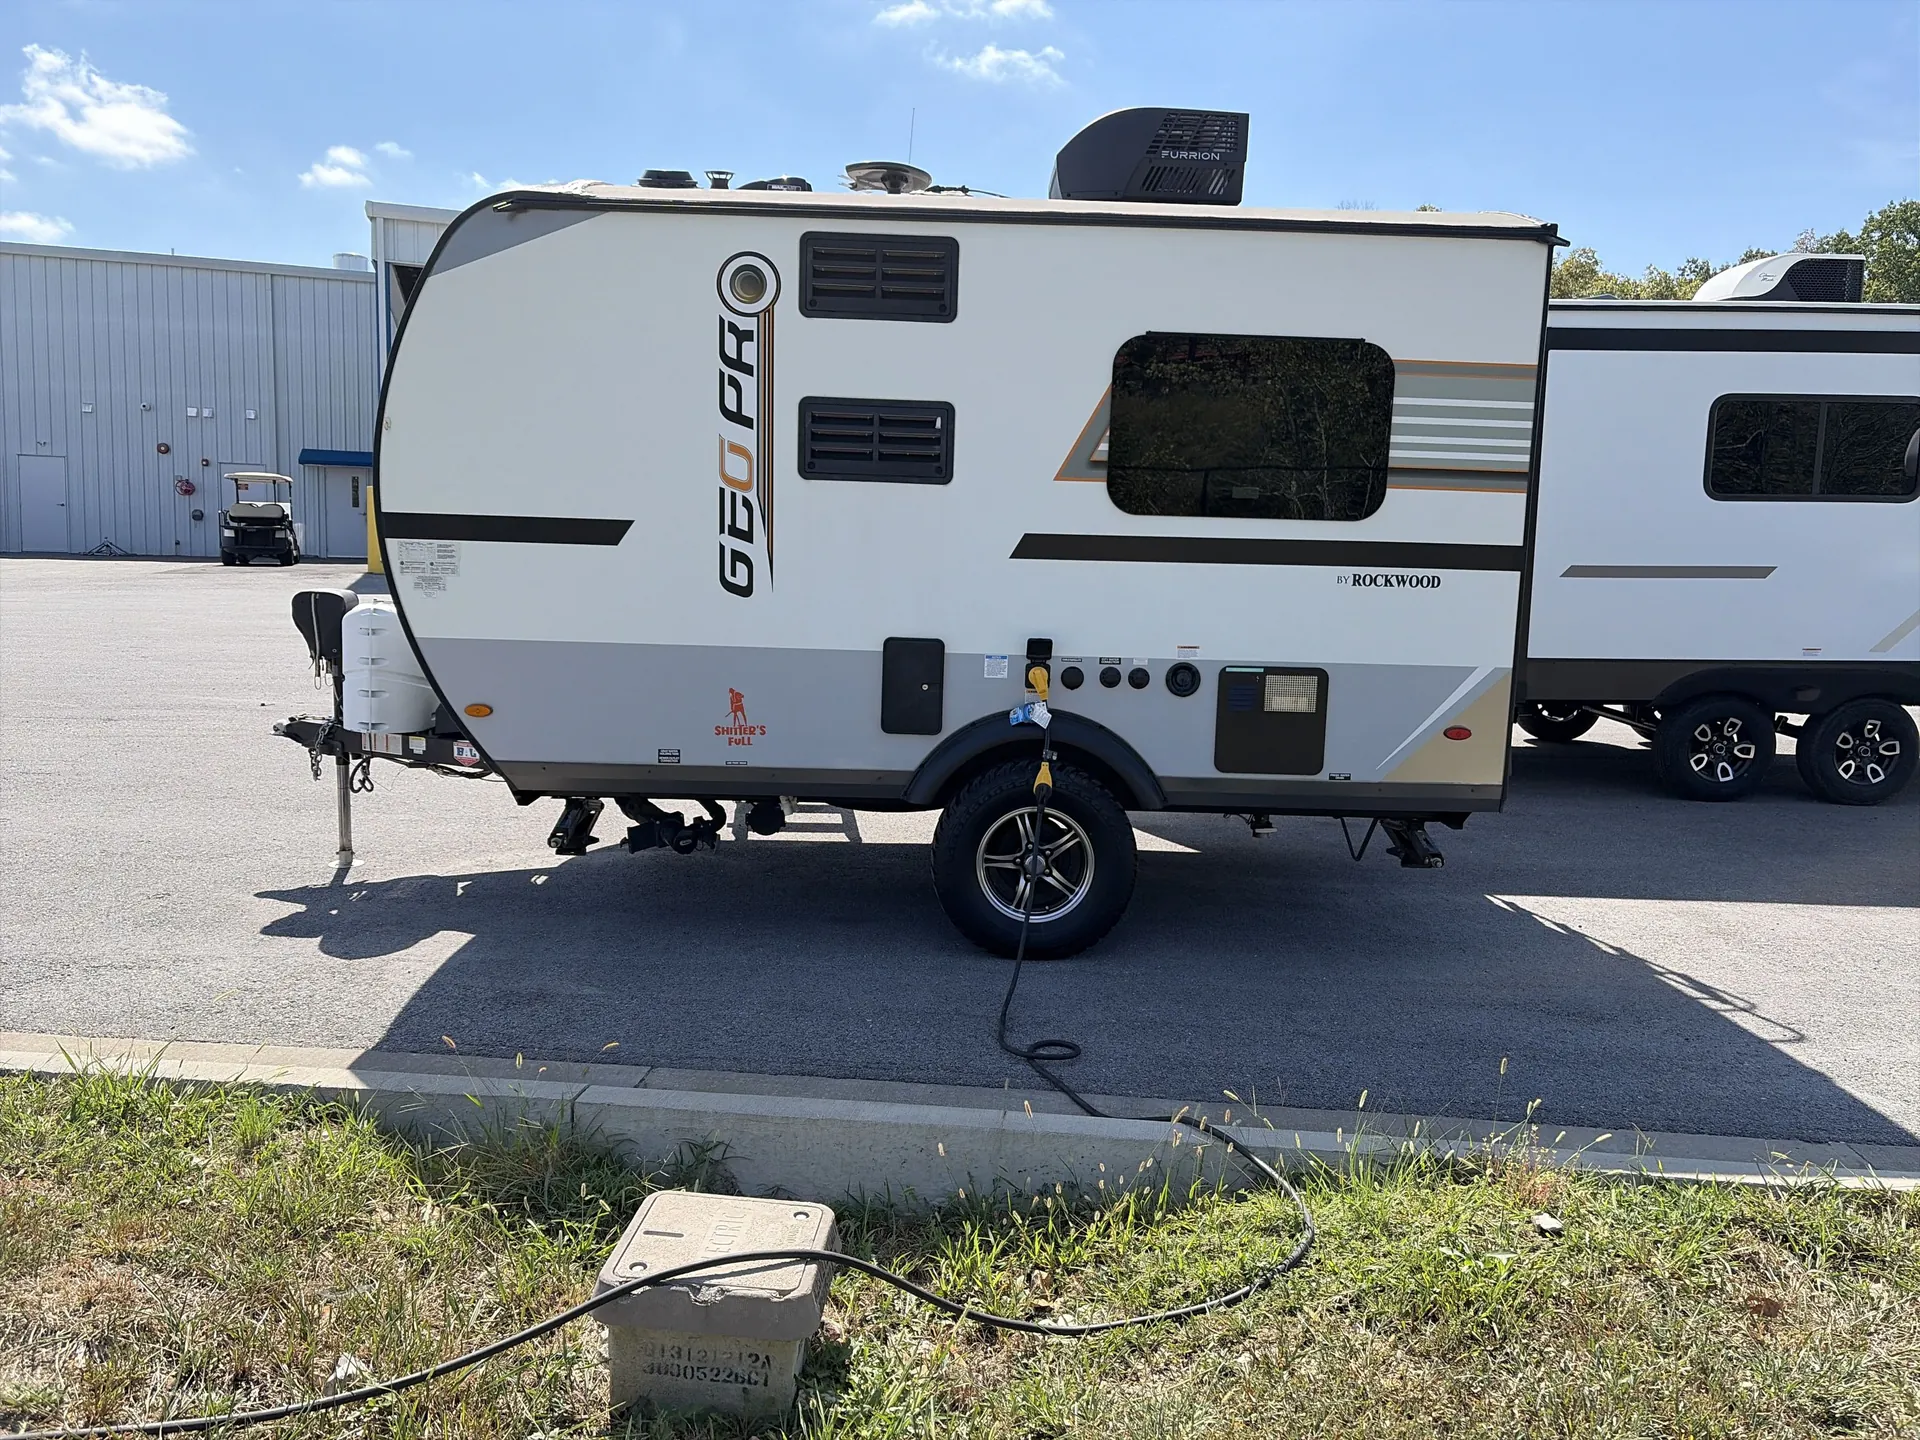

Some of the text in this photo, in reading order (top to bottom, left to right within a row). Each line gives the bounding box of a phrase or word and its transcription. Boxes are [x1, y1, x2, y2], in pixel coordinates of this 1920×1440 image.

[1161, 150, 1220, 161] FURRION
[716, 250, 782, 599] GEO PRO
[1336, 573, 1442, 589] BY ROCKWOOD
[714, 725, 767, 736] SHITTER'S
[727, 736, 753, 746] FULL
